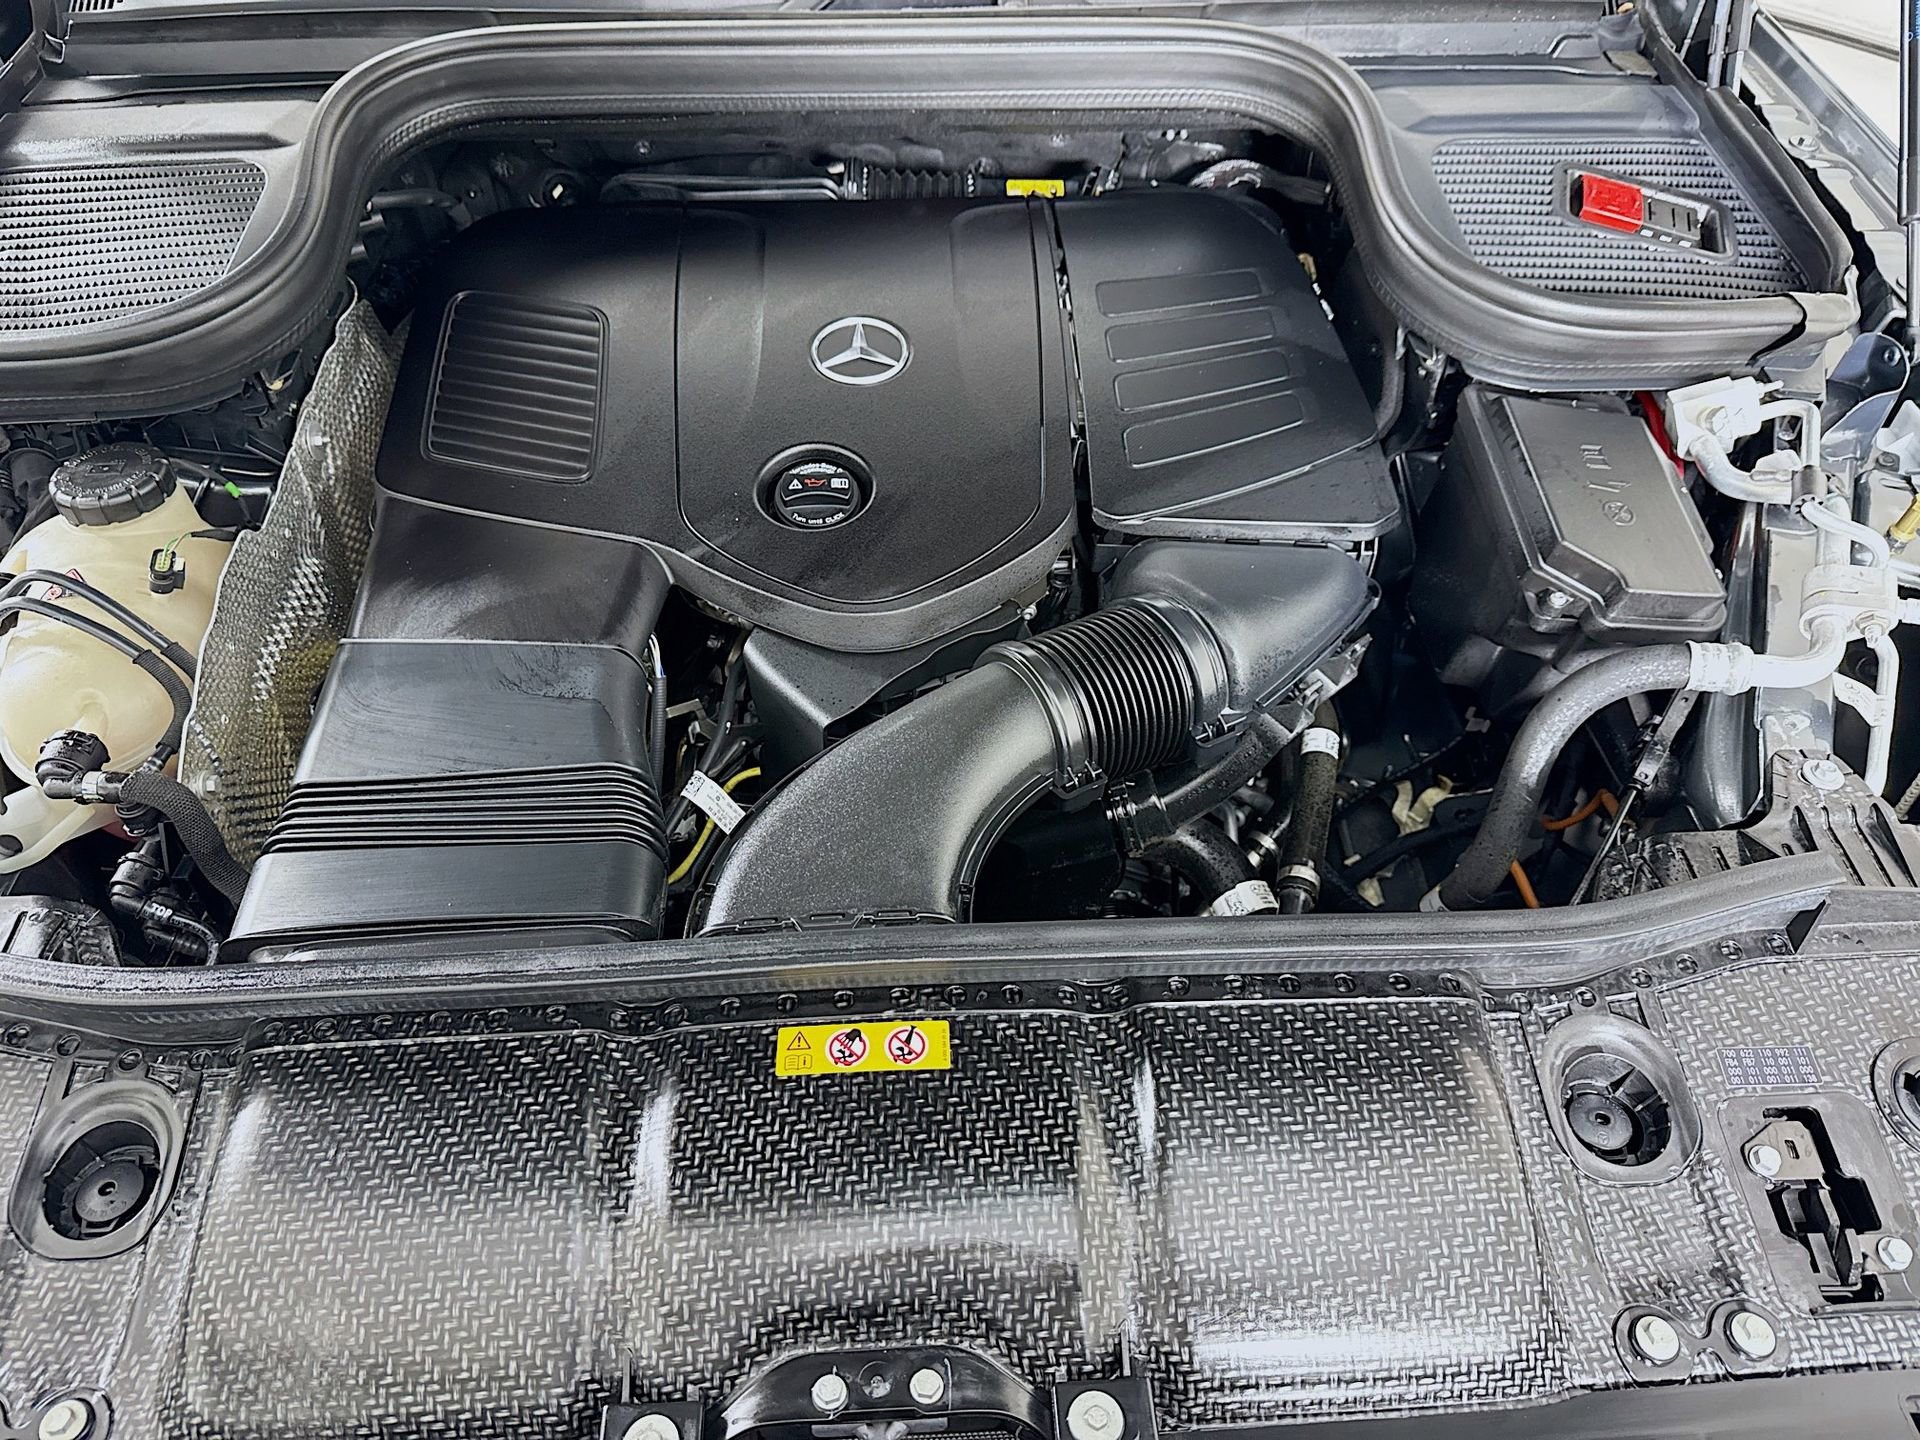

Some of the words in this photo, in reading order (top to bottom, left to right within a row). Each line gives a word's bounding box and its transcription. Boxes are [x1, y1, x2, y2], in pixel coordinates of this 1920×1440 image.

[792, 513, 806, 523] Turn
[825, 512, 845, 523] CLICK
[151, 903, 173, 918] TOP
[1740, 1049, 1754, 1057] 622
[1758, 1049, 1771, 1057] 110
[1775, 1049, 1789, 1057] 992
[1793, 1049, 1807, 1057] 111
[1731, 1076, 1744, 1084] 001
[1767, 1075, 1780, 1083] 001
[1785, 1075, 1798, 1083] 011
